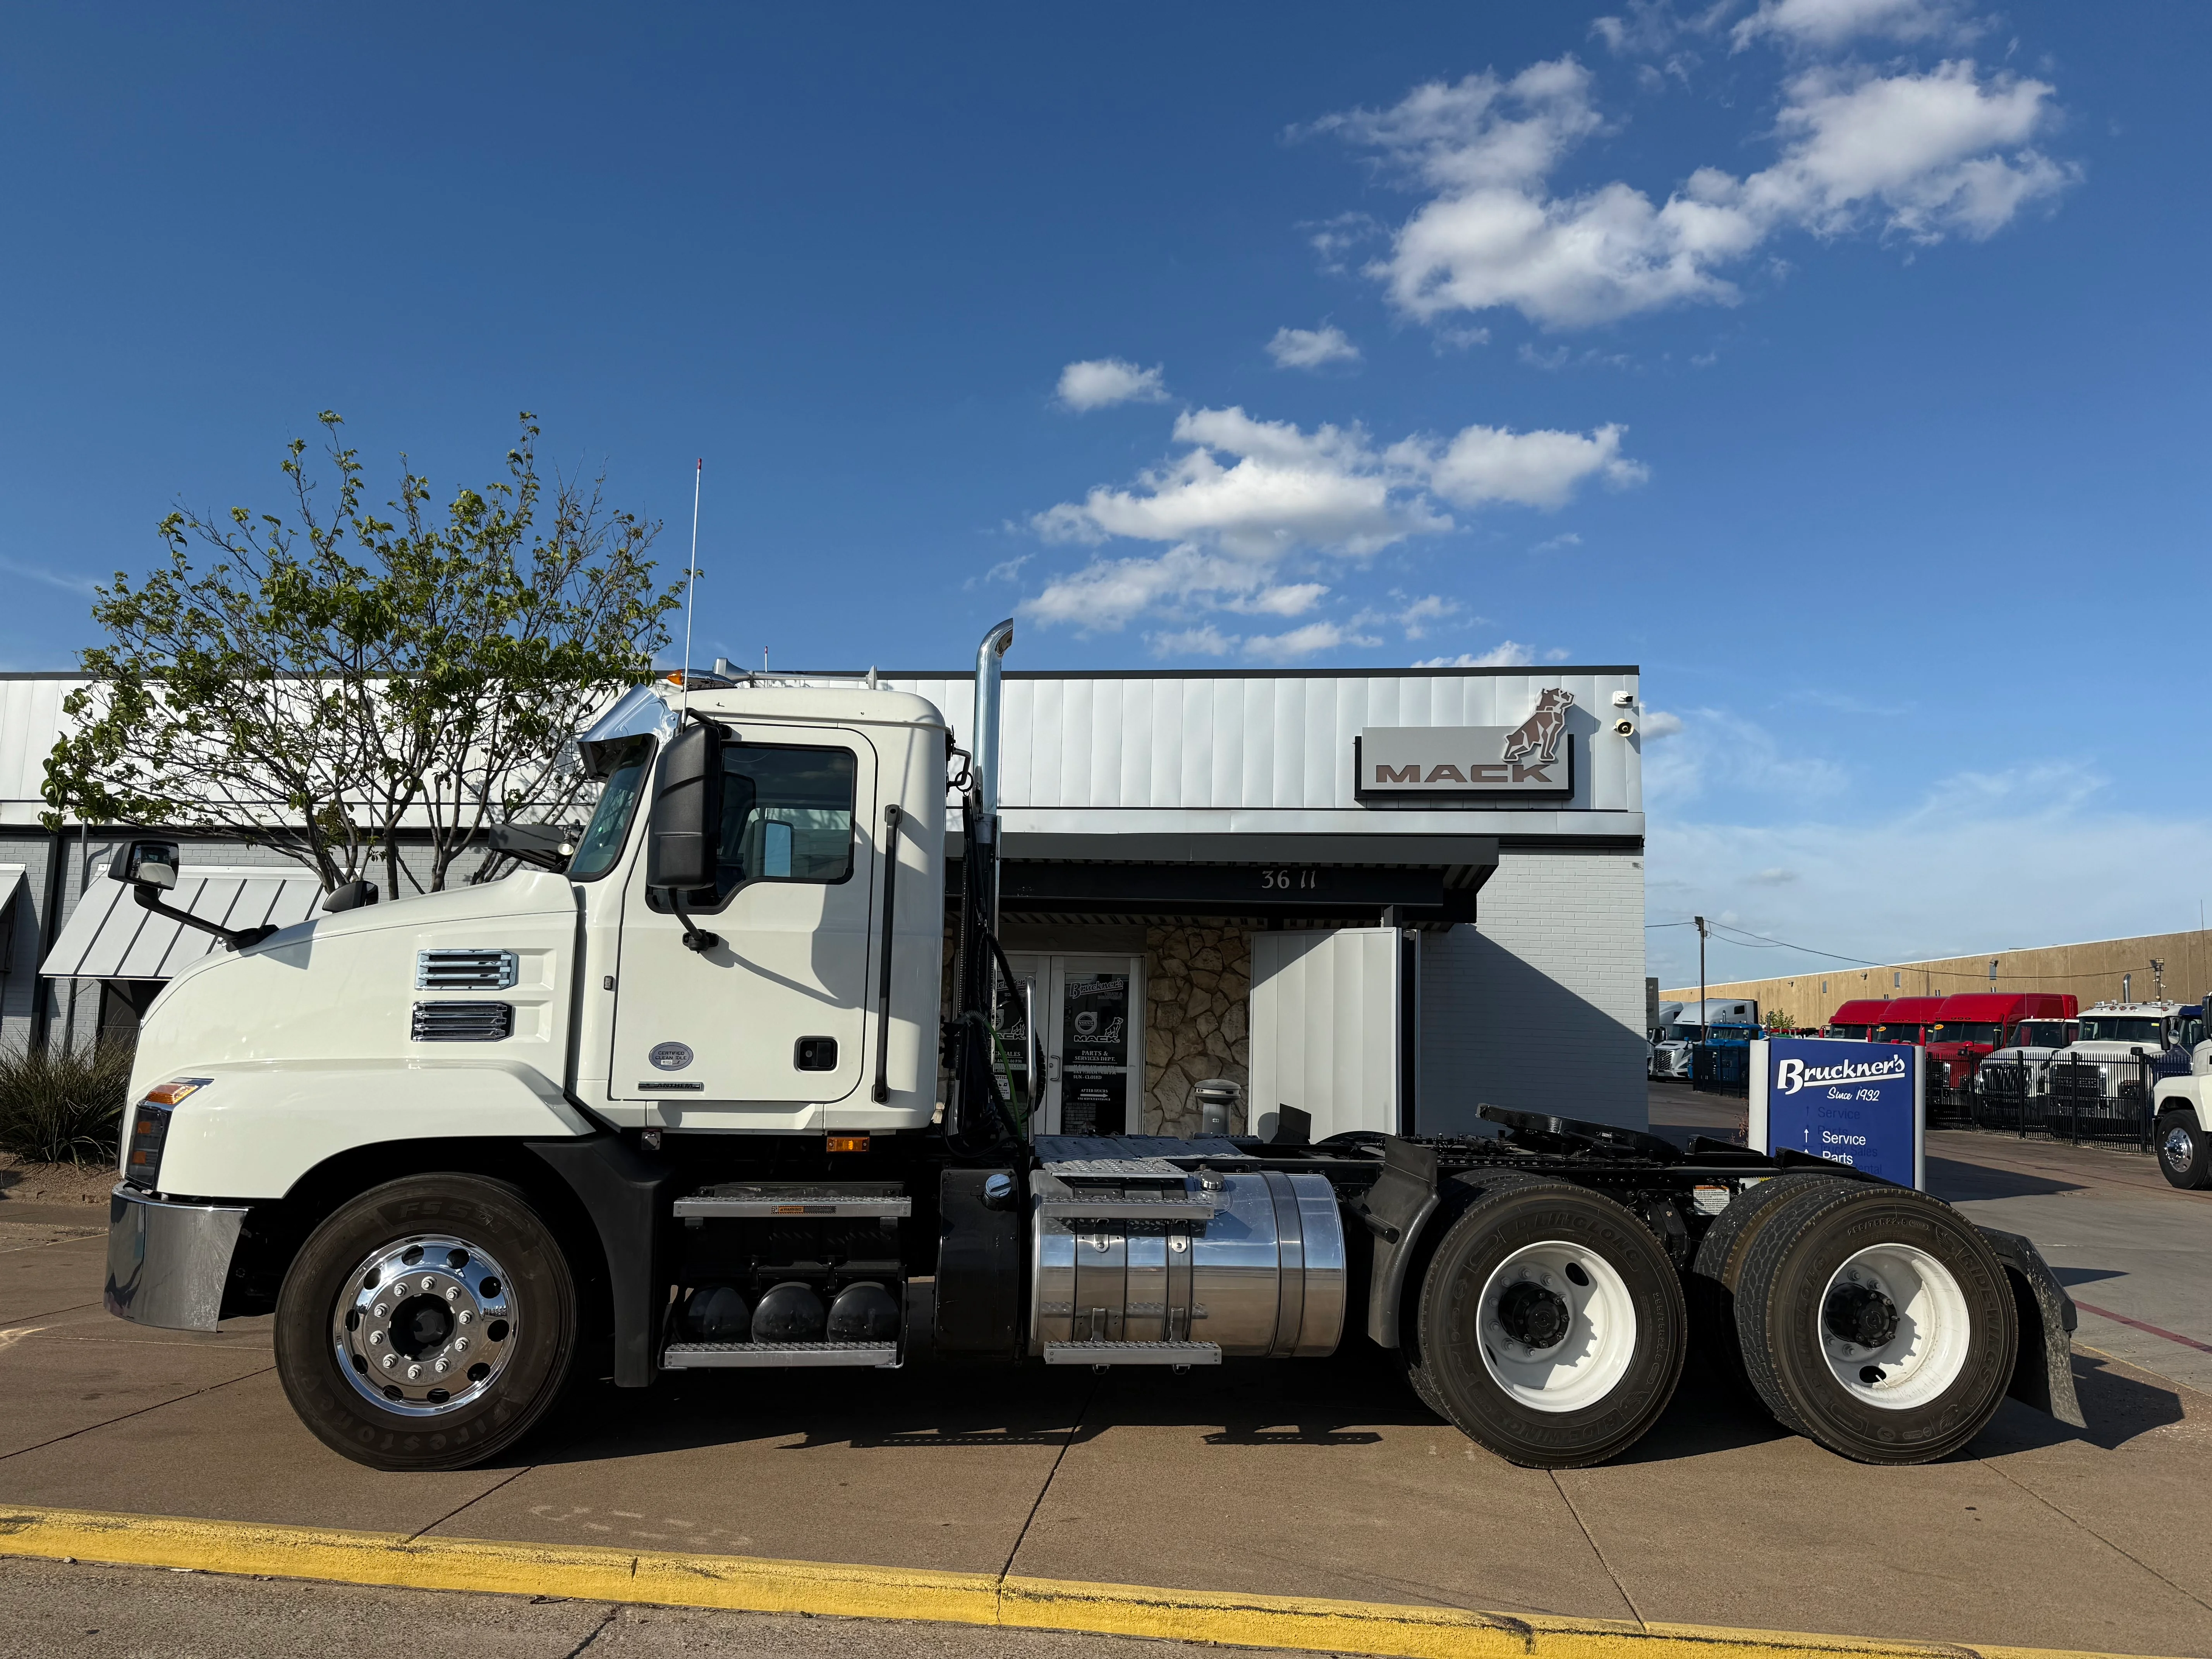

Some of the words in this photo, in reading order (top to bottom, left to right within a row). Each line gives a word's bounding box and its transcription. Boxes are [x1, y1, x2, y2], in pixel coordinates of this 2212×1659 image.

[1376, 764, 1553, 783] MACK
[1261, 869, 1316, 889] 3611
[1069, 978, 1123, 1000] Bruckner's
[1777, 1054, 1905, 1095] Bruckner's
[1827, 1087, 1852, 1101] Since
[1856, 1086, 1880, 1102] 1932
[1818, 1106, 1860, 1119] Service
[1822, 1131, 1866, 1146] Service
[398, 1201, 443, 1219] FS
[1848, 1218, 1907, 1236] 295/75R22.5
[1534, 1212, 1640, 1263] LINGLONG
[317, 1393, 512, 1452] Firestone
